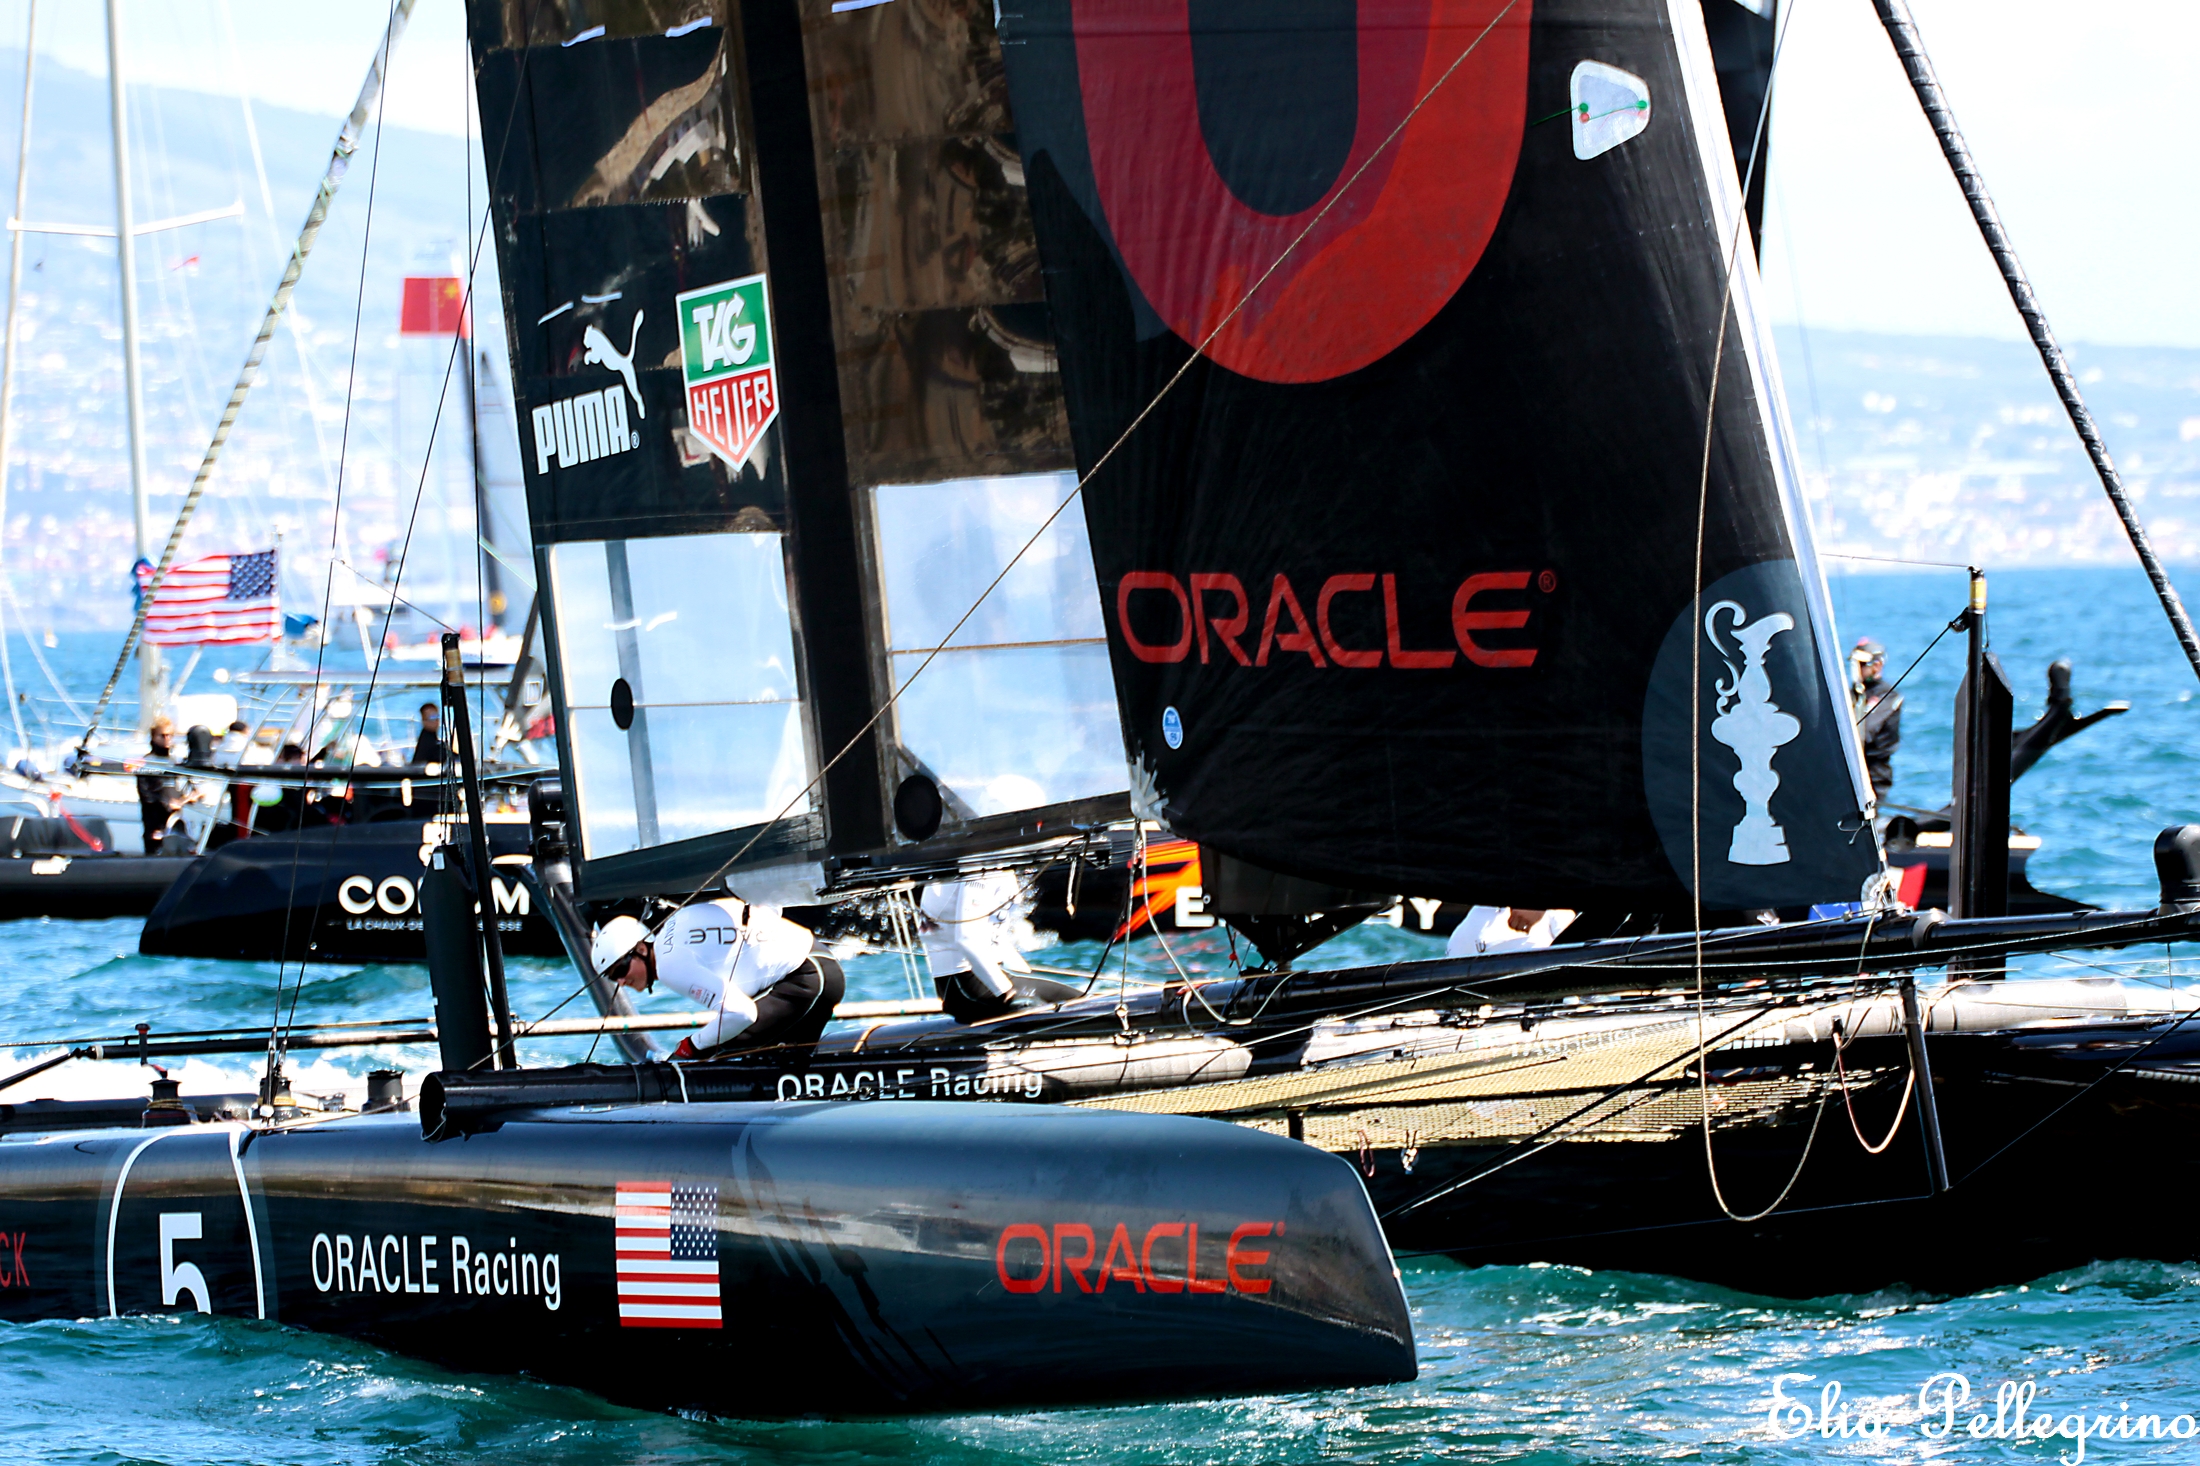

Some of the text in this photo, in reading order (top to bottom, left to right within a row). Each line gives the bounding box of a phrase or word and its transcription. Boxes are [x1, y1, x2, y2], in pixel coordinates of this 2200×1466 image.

[693, 292, 756, 372] TAG
[532, 384, 631, 475] PUMA
[690, 375, 772, 456] HEUER
[1117, 571, 1538, 669] ORACLE
[338, 875, 530, 915] COM
[1175, 886, 1442, 930] EGY
[930, 1067, 1043, 1098] Racing
[159, 1212, 212, 1315] 5
[311, 1232, 561, 1311] ORACLE Racing
[996, 1222, 1274, 1294] ORACLE
